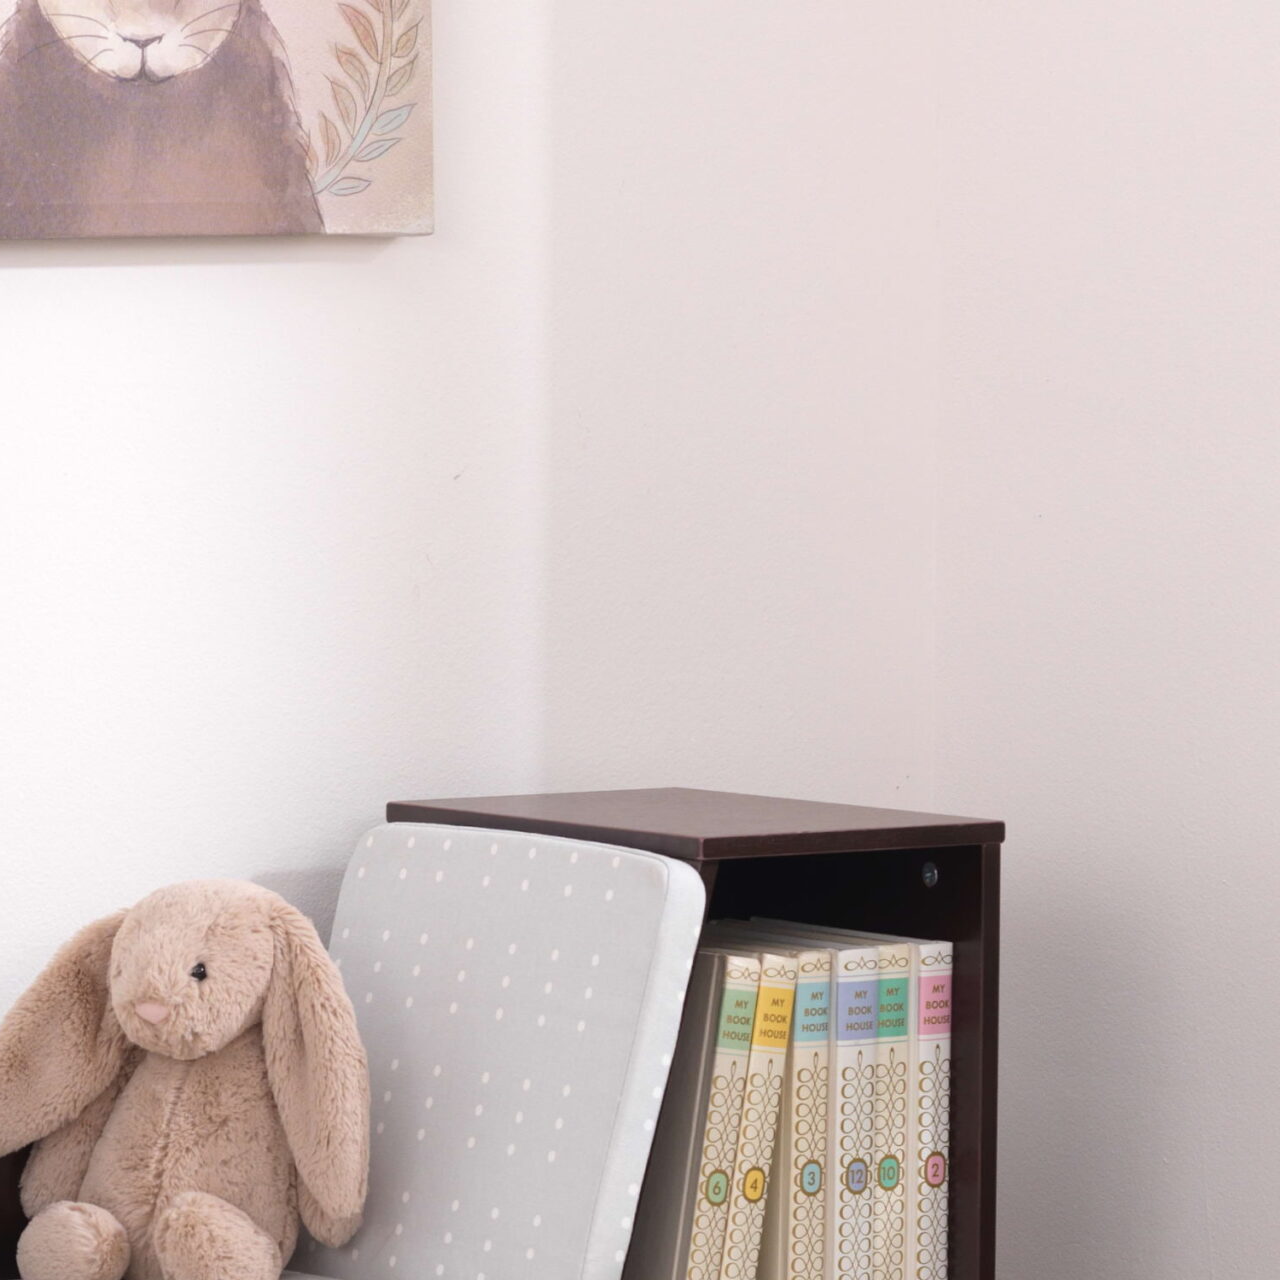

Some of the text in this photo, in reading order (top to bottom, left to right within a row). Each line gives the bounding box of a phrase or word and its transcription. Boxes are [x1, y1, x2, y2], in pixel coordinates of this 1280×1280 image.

[886, 987, 900, 997] MY
[932, 984, 945, 993] MY
[810, 991, 824, 1001] MY
[854, 990, 868, 1000] MY
[735, 1000, 749, 1009] MY
[771, 998, 785, 1007] MY
[880, 1002, 904, 1013] BOOK
[925, 1000, 949, 1010] BOOK
[804, 1007, 828, 1017] BOOK
[848, 1006, 873, 1016] BOOK
[726, 1015, 751, 1025] BOOK
[763, 1013, 788, 1024] BOOK
[877, 1018, 904, 1028] HOUSE
[923, 1015, 951, 1025] HOUSE
[801, 1022, 829, 1032] HOUSE
[846, 1020, 873, 1031] HOUSE
[722, 1030, 751, 1042] HOUSE
[759, 1028, 787, 1040] HOUSE
[882, 1166, 896, 1180] 10
[932, 1163, 940, 1177] 2
[807, 1171, 816, 1186] 3
[850, 1169, 863, 1184] 12
[713, 1180, 721, 1195] 6
[750, 1178, 759, 1192] 4
